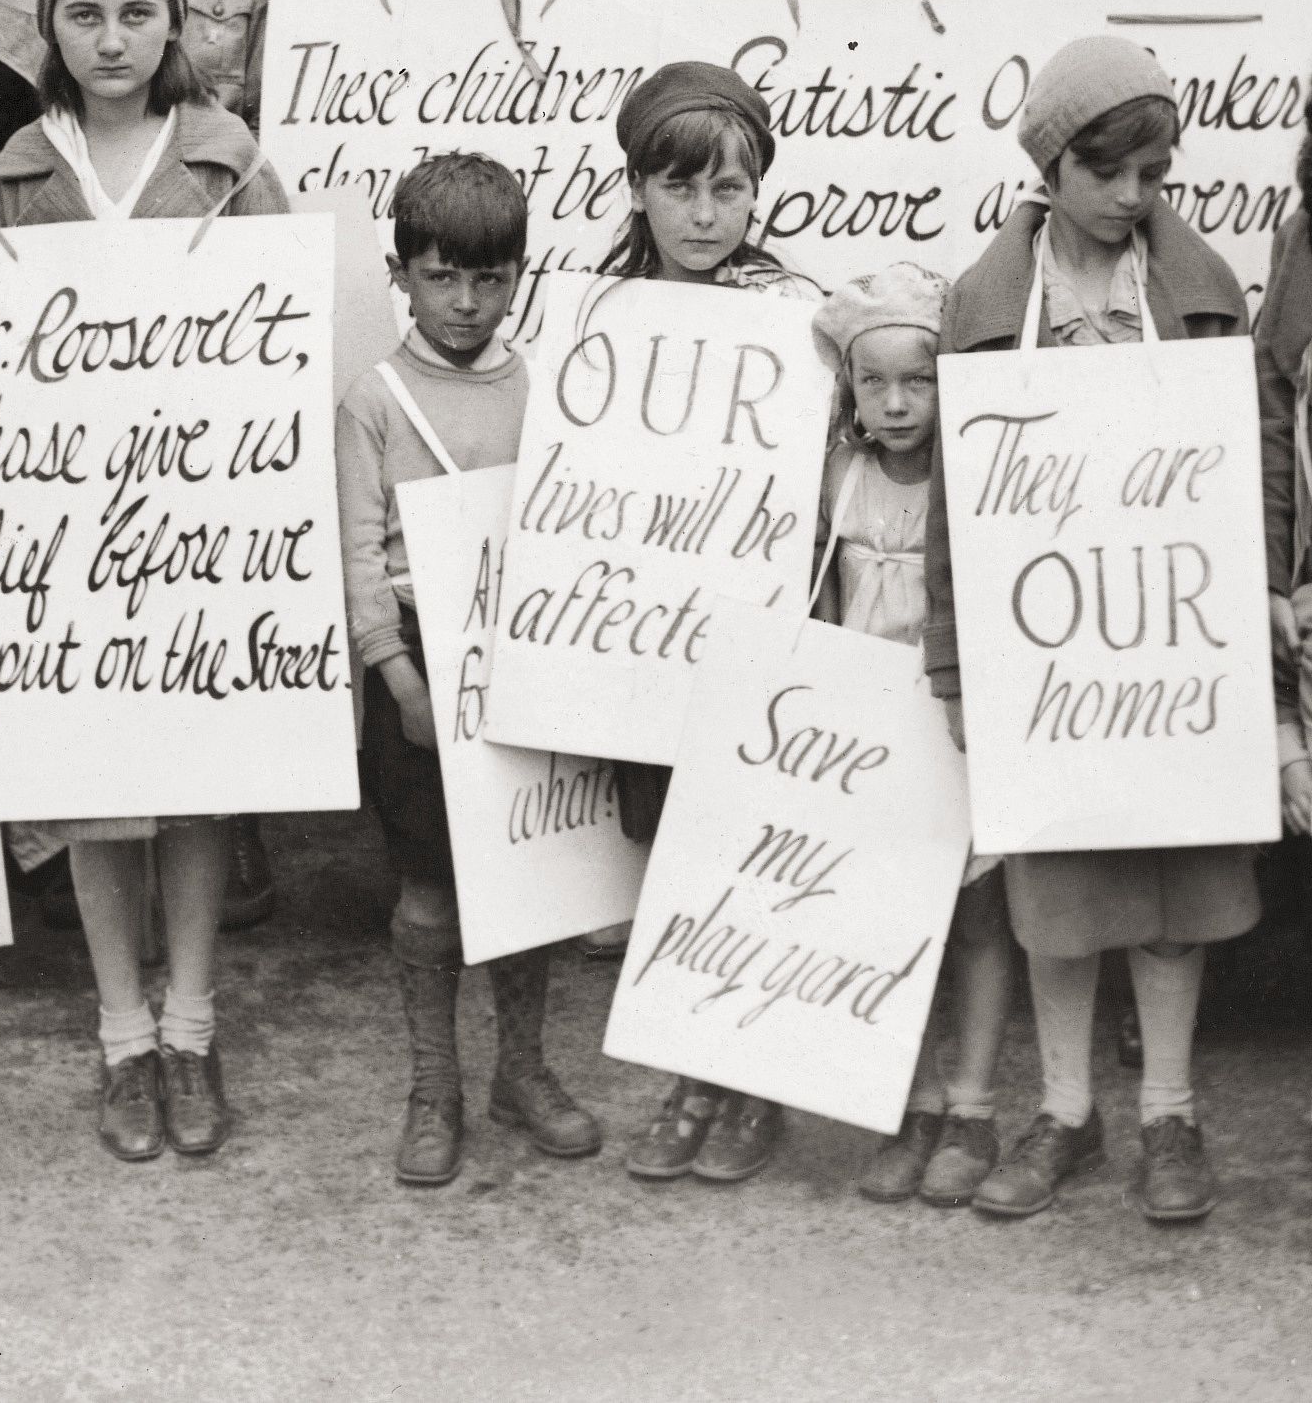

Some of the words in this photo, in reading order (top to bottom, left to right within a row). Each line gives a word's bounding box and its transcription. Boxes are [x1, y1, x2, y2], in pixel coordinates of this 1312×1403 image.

[280, 40, 409, 127] These
[417, 39, 644, 126] children
[551, 144, 625, 220] be
[15, 281, 311, 383] Roosevelt,
[555, 331, 785, 450] OUR
[100, 409, 213, 524] give
[227, 409, 301, 480] us
[519, 442, 638, 541] lives
[642, 467, 742, 557] will
[732, 474, 798, 563] be
[959, 409, 1087, 538] They
[1122, 444, 1226, 509] are
[87, 494, 231, 620] before
[241, 518, 314, 582] we
[1011, 541, 1228, 651] OUR
[94, 635, 153, 693] on
[160, 608, 230, 701] the
[509, 560, 784, 664] affecte
[736, 684, 890, 795] Save
[1025, 660, 1228, 743] homes
[738, 824, 855, 913] my
